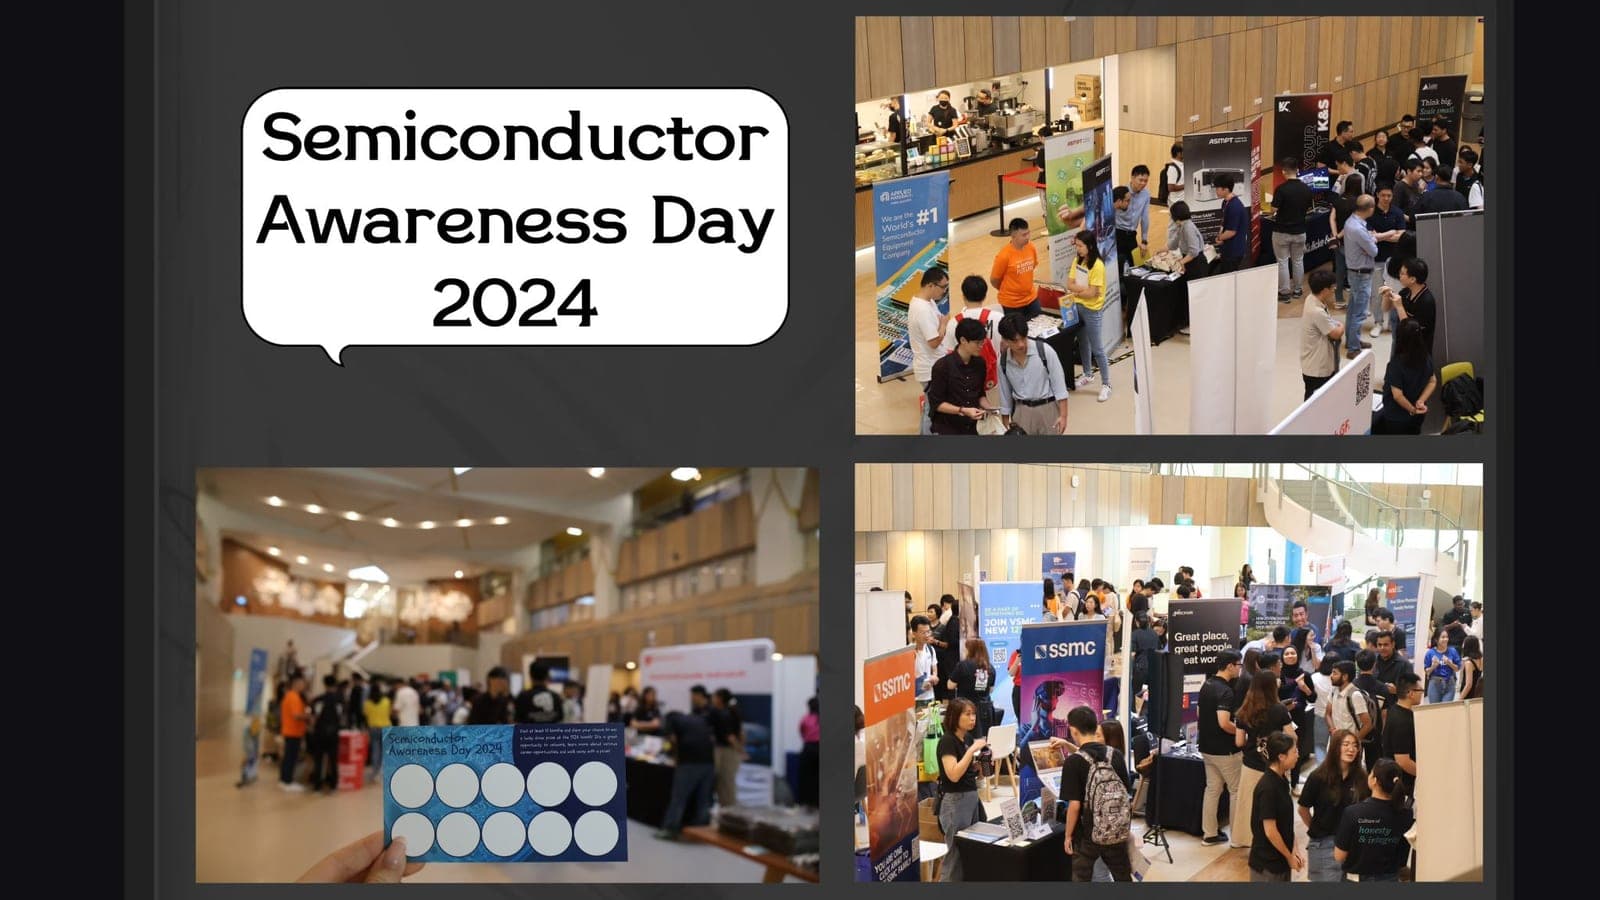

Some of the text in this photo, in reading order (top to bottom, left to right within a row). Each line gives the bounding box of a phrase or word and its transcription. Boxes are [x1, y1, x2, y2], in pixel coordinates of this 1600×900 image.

[881, 215, 893, 223] We
[916, 207, 938, 226] #1
[882, 221, 914, 233] World's
[984, 618, 1007, 627] JOIN
[985, 626, 1008, 635] NEW
[1174, 631, 1229, 643] Great place,
[1049, 641, 1096, 658] ssmc
[1174, 644, 1198, 656] great
[882, 672, 911, 699] ssmc
[388, 731, 468, 744] Semiconductor
[388, 743, 503, 759] Awareness Day 2024
[1358, 826, 1391, 836] honesty
